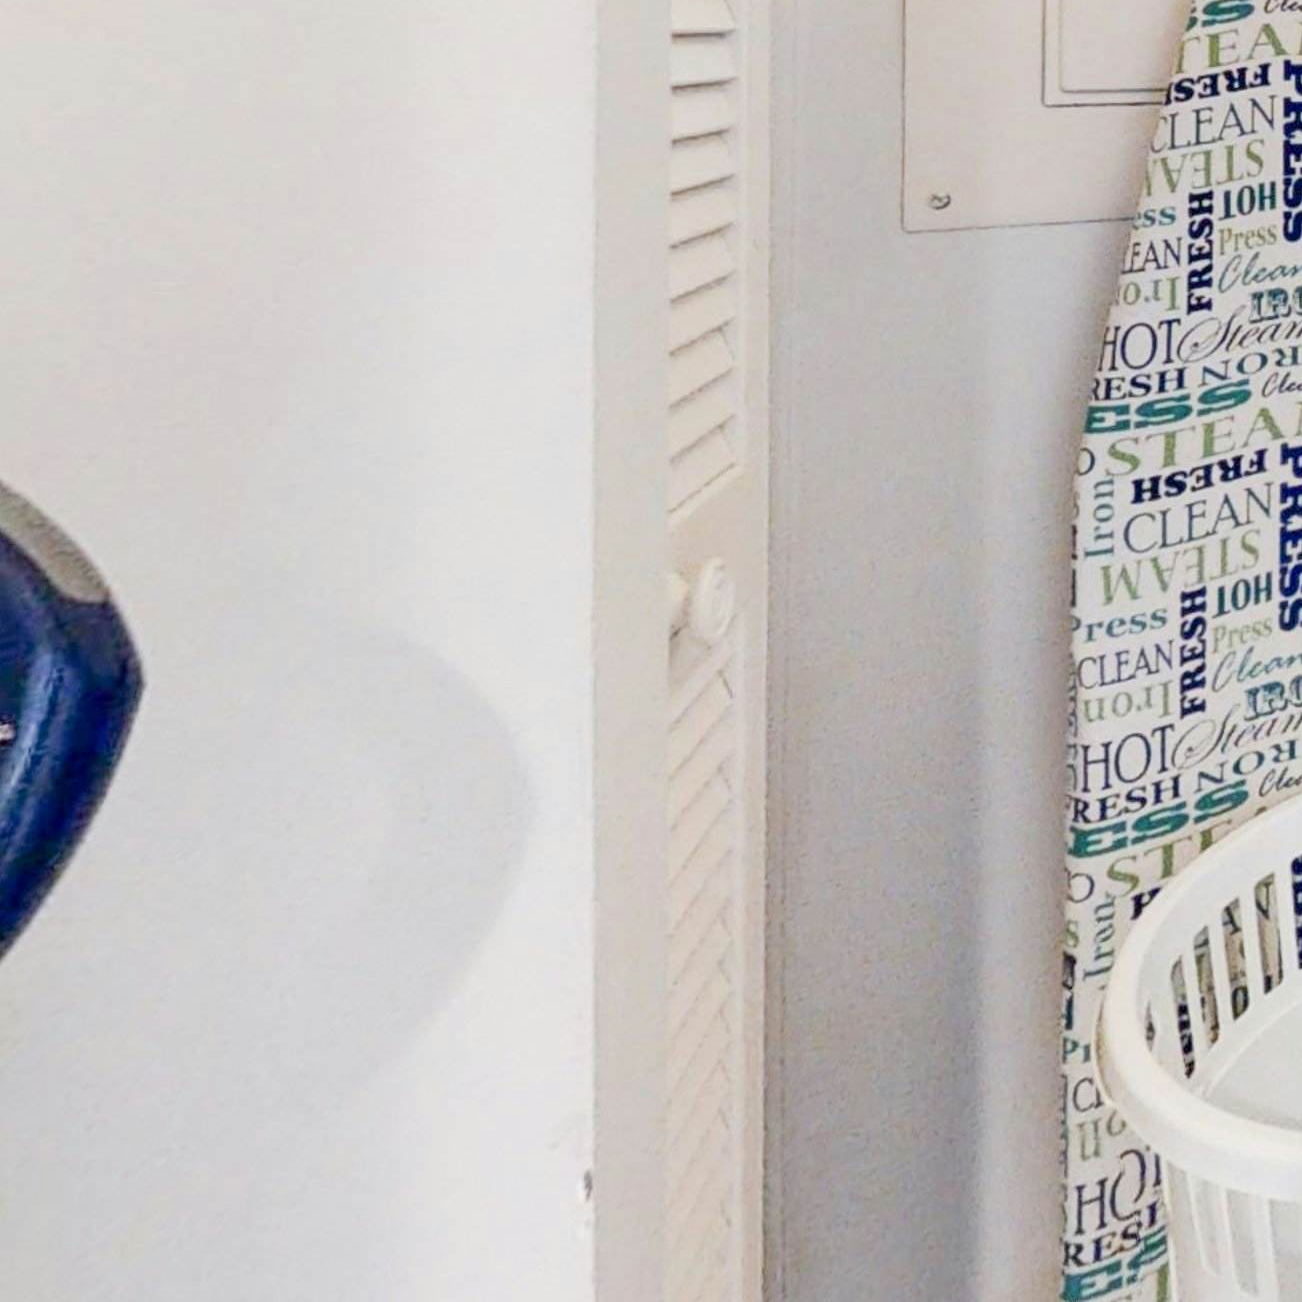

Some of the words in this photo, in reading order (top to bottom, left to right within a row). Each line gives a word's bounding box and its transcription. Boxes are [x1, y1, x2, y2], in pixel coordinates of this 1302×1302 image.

[1163, 62, 1272, 106] FRES
[1217, 181, 1277, 221] HOT
[1121, 237, 1182, 275] EAN
[1187, 189, 1214, 315] FRESH
[1218, 225, 1278, 256] Press
[1114, 276, 1181, 312] Iro
[1097, 318, 1181, 372] HOT
[1130, 448, 1269, 505] FRESH
[1084, 478, 1116, 560] Iron
[1122, 482, 1275, 554] CLEAN
[1100, 529, 1262, 607] STEAM
[1212, 571, 1273, 619] HOT
[1178, 586, 1208, 719] FRESH
[1211, 617, 1273, 654] Press
[1077, 638, 1175, 690] CLEAN
[1083, 679, 1174, 723] Iron
[1079, 723, 1176, 794] HOT
